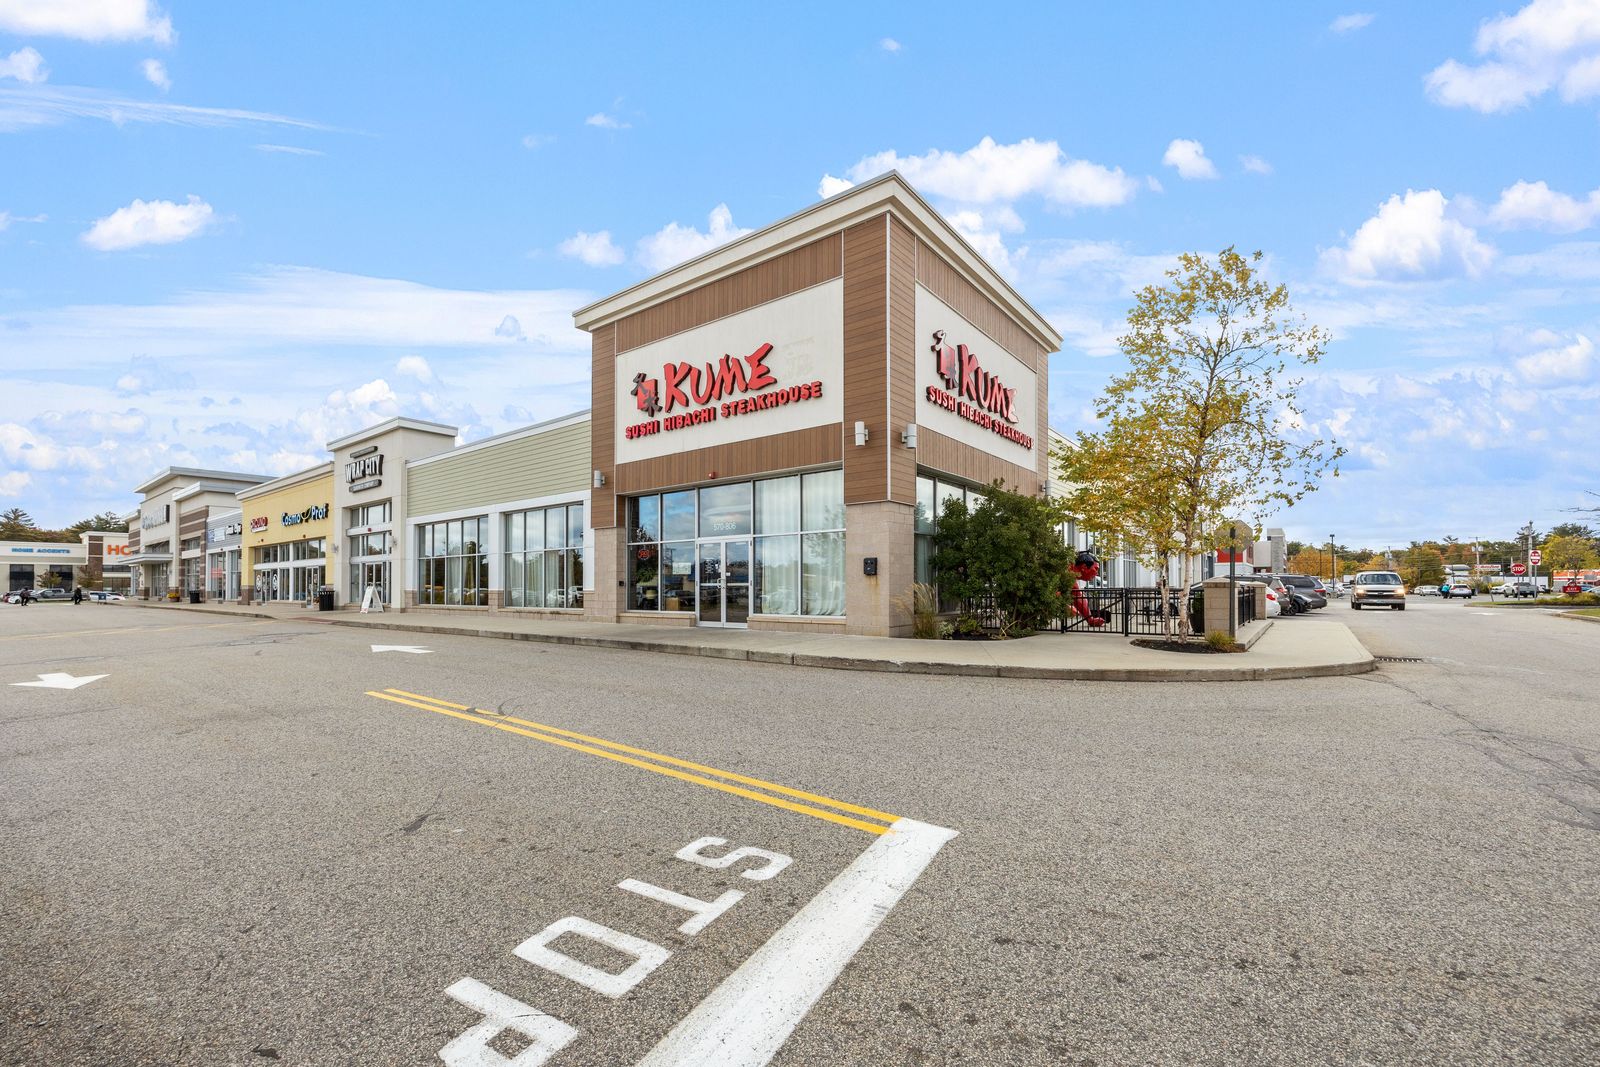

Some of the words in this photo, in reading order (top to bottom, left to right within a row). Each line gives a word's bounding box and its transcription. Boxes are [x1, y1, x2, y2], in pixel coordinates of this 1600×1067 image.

[664, 342, 777, 413] KUME
[957, 344, 1019, 423] KUME
[626, 420, 660, 439] SUSHI
[664, 407, 717, 431] HIBACHI
[720, 381, 823, 417] STEAKHOUSE
[926, 385, 957, 413] SUSHI
[957, 401, 992, 431] HIBACHI
[345, 460, 366, 483] WRAP
[365, 454, 384, 476] CITY
[281, 512, 303, 527] Cosmo
[311, 503, 329, 520] Prof
[438, 836, 793, 1067] STOP
